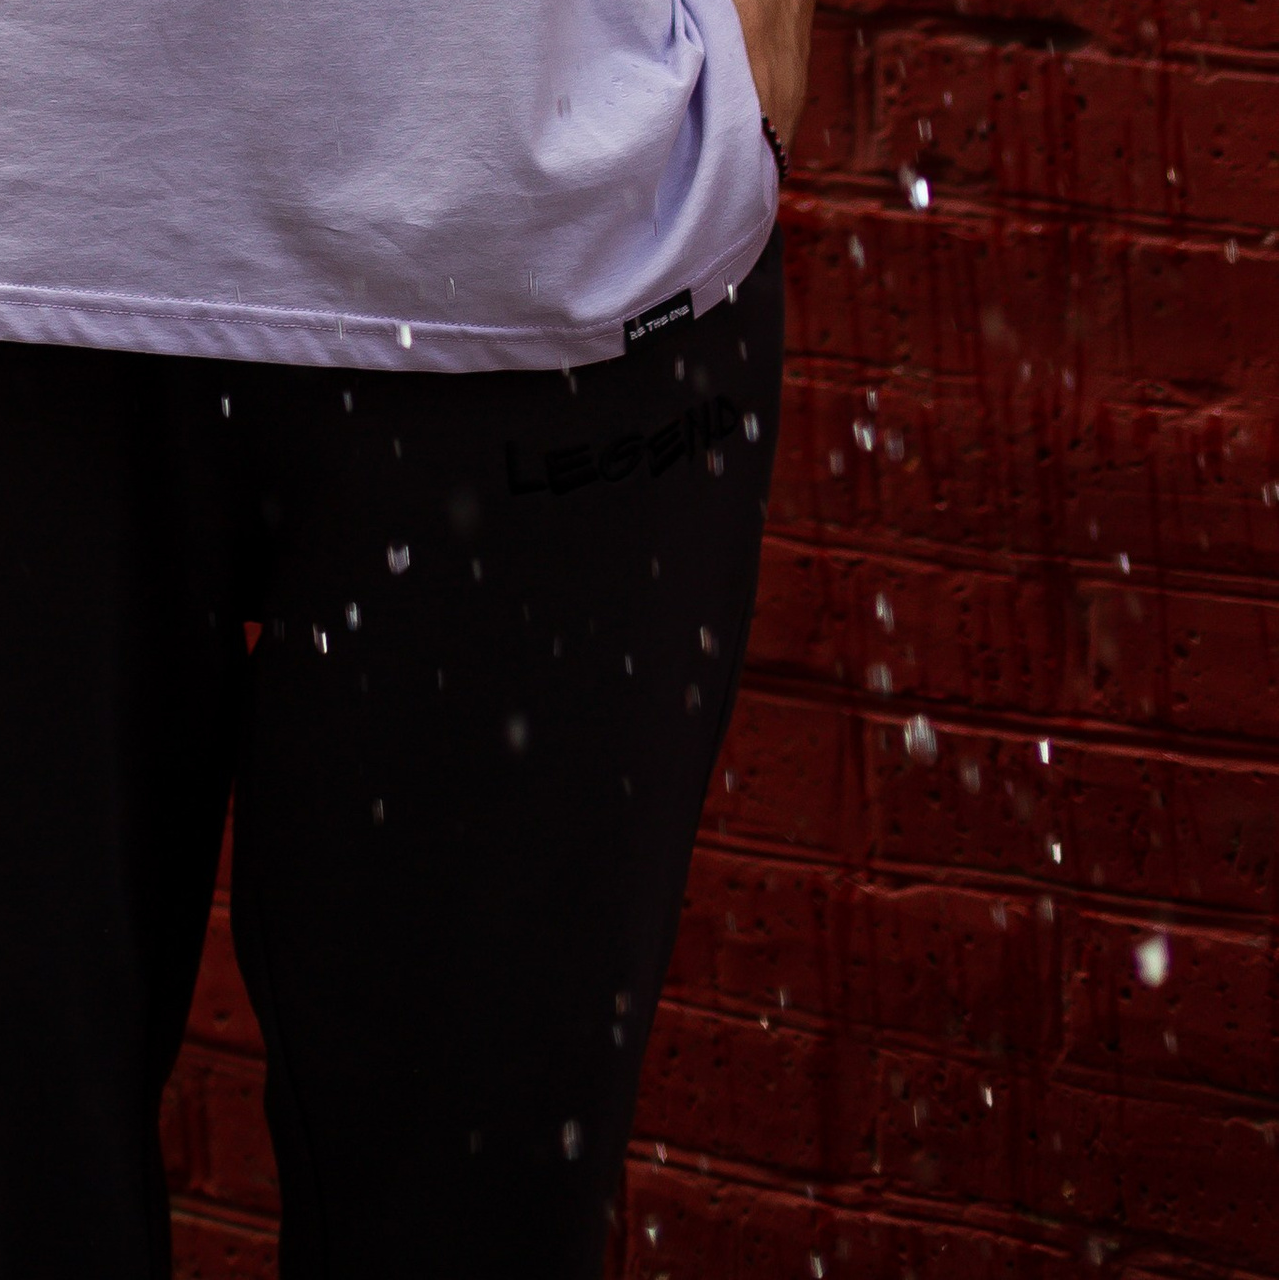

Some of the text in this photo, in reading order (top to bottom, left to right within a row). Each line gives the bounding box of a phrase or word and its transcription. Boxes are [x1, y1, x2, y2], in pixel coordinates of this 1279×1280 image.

[645, 314, 669, 332] THE
[669, 304, 690, 321] ONE
[506, 395, 740, 496] LEGEND
